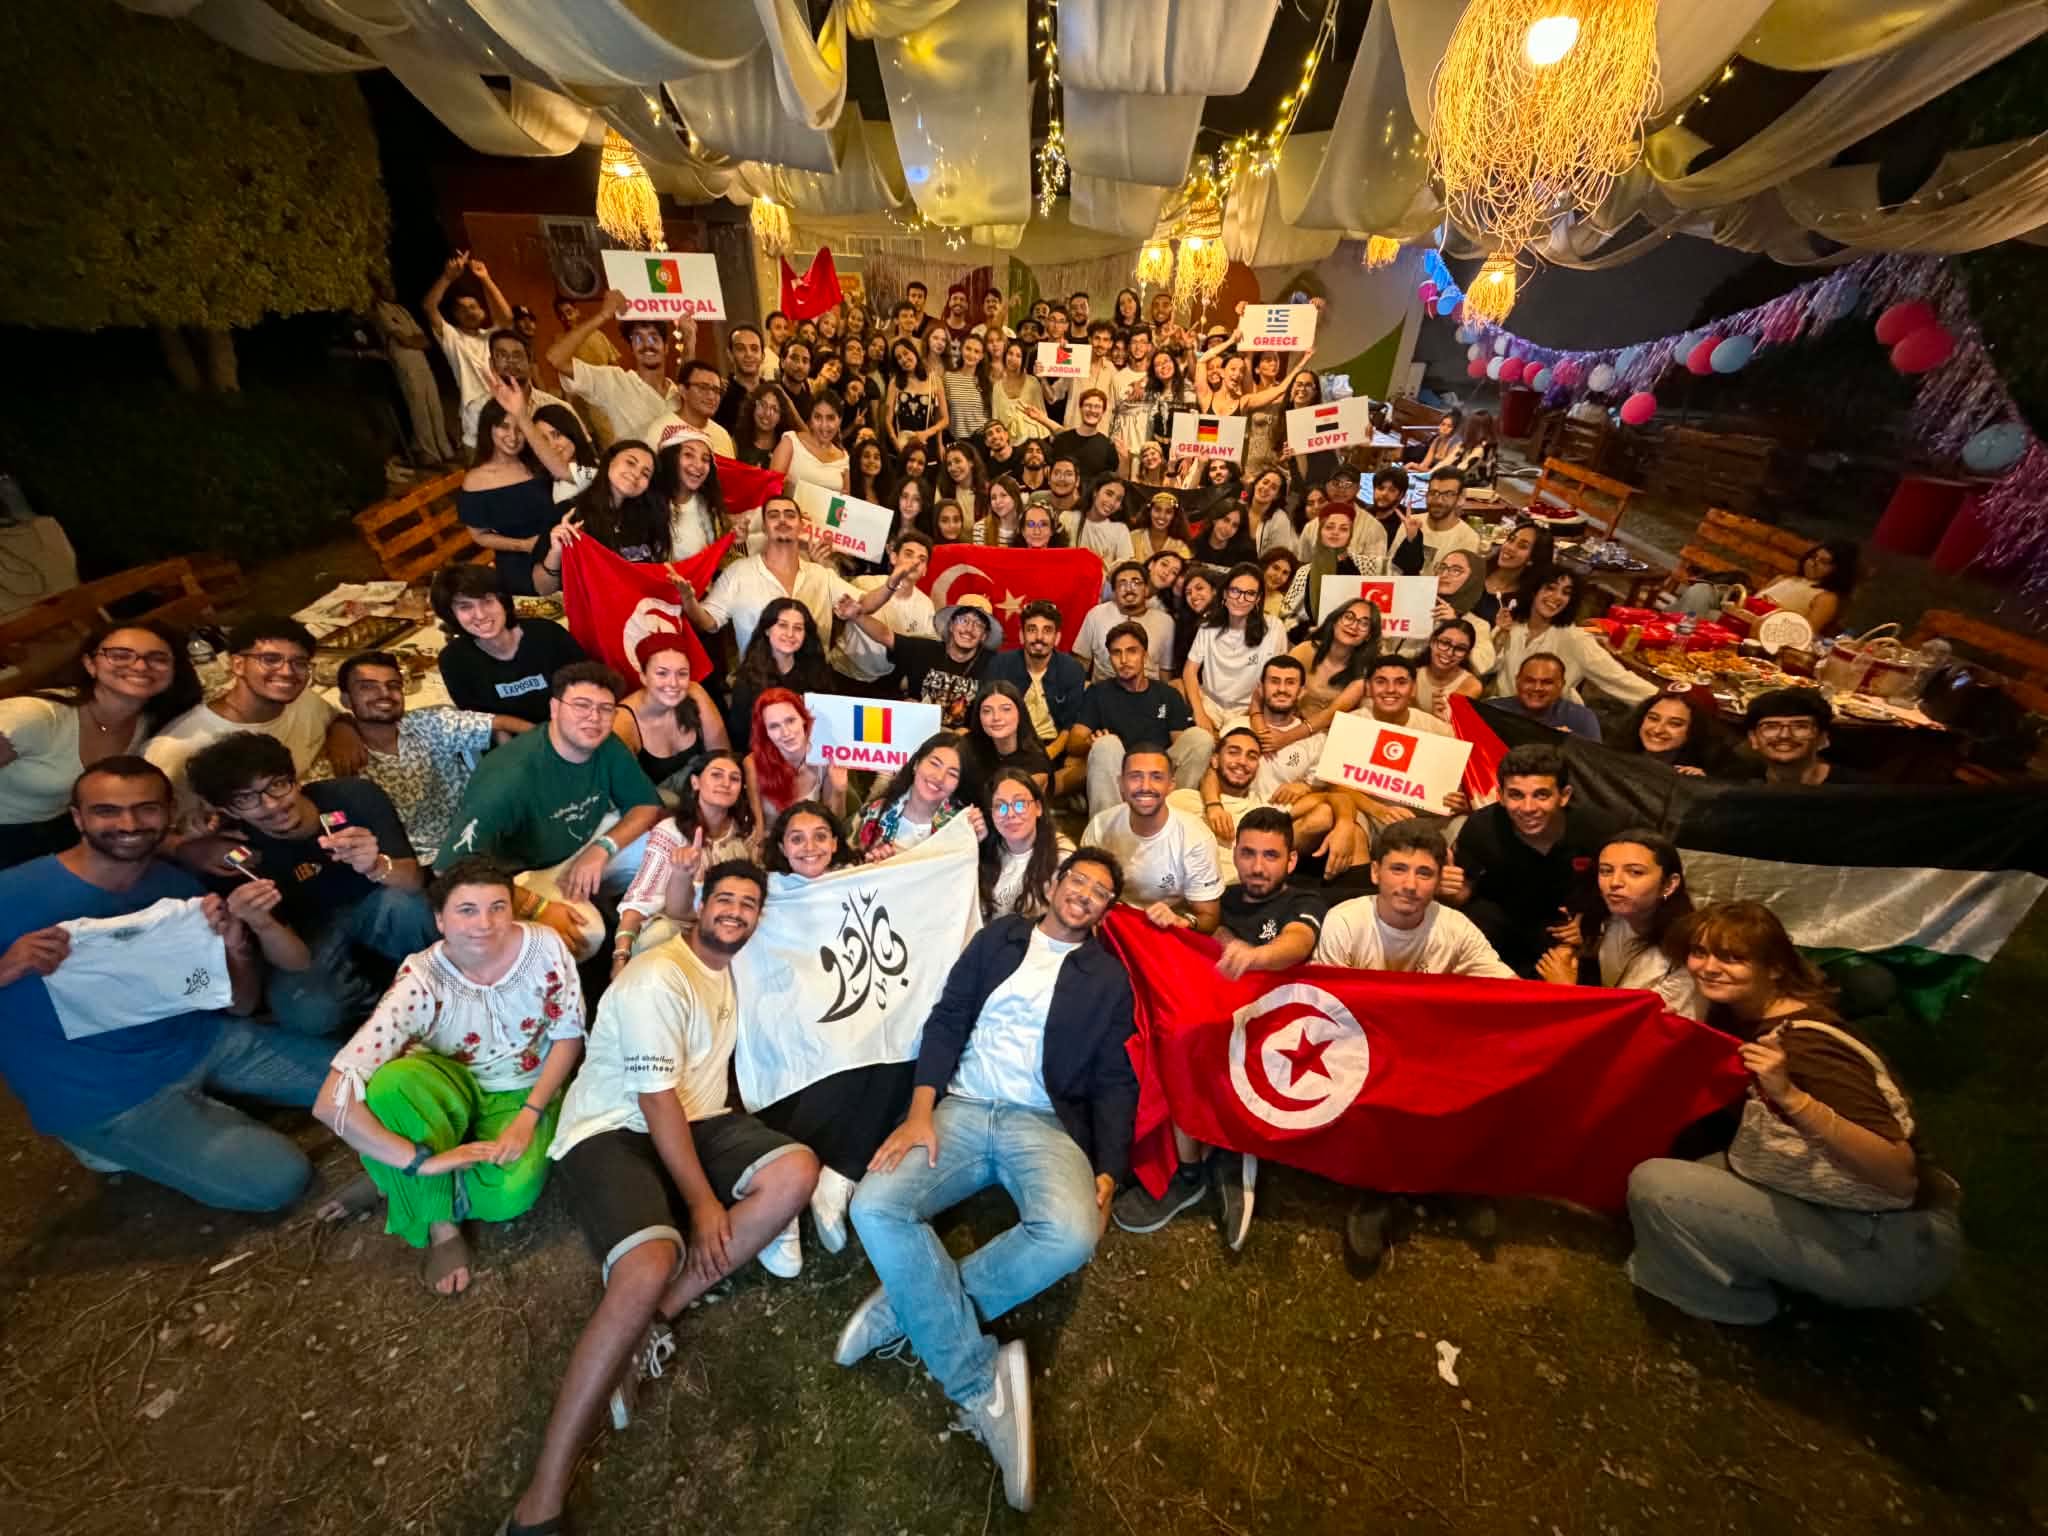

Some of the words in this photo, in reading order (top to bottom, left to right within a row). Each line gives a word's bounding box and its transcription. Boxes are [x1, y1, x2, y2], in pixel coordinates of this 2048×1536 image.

[623, 299, 718, 314] PORTUGAL
[1253, 336, 1299, 346] GREECE
[1307, 432, 1349, 448] EGYPT
[821, 744, 909, 765] ROMANI
[1343, 764, 1426, 800] TUNISIA
